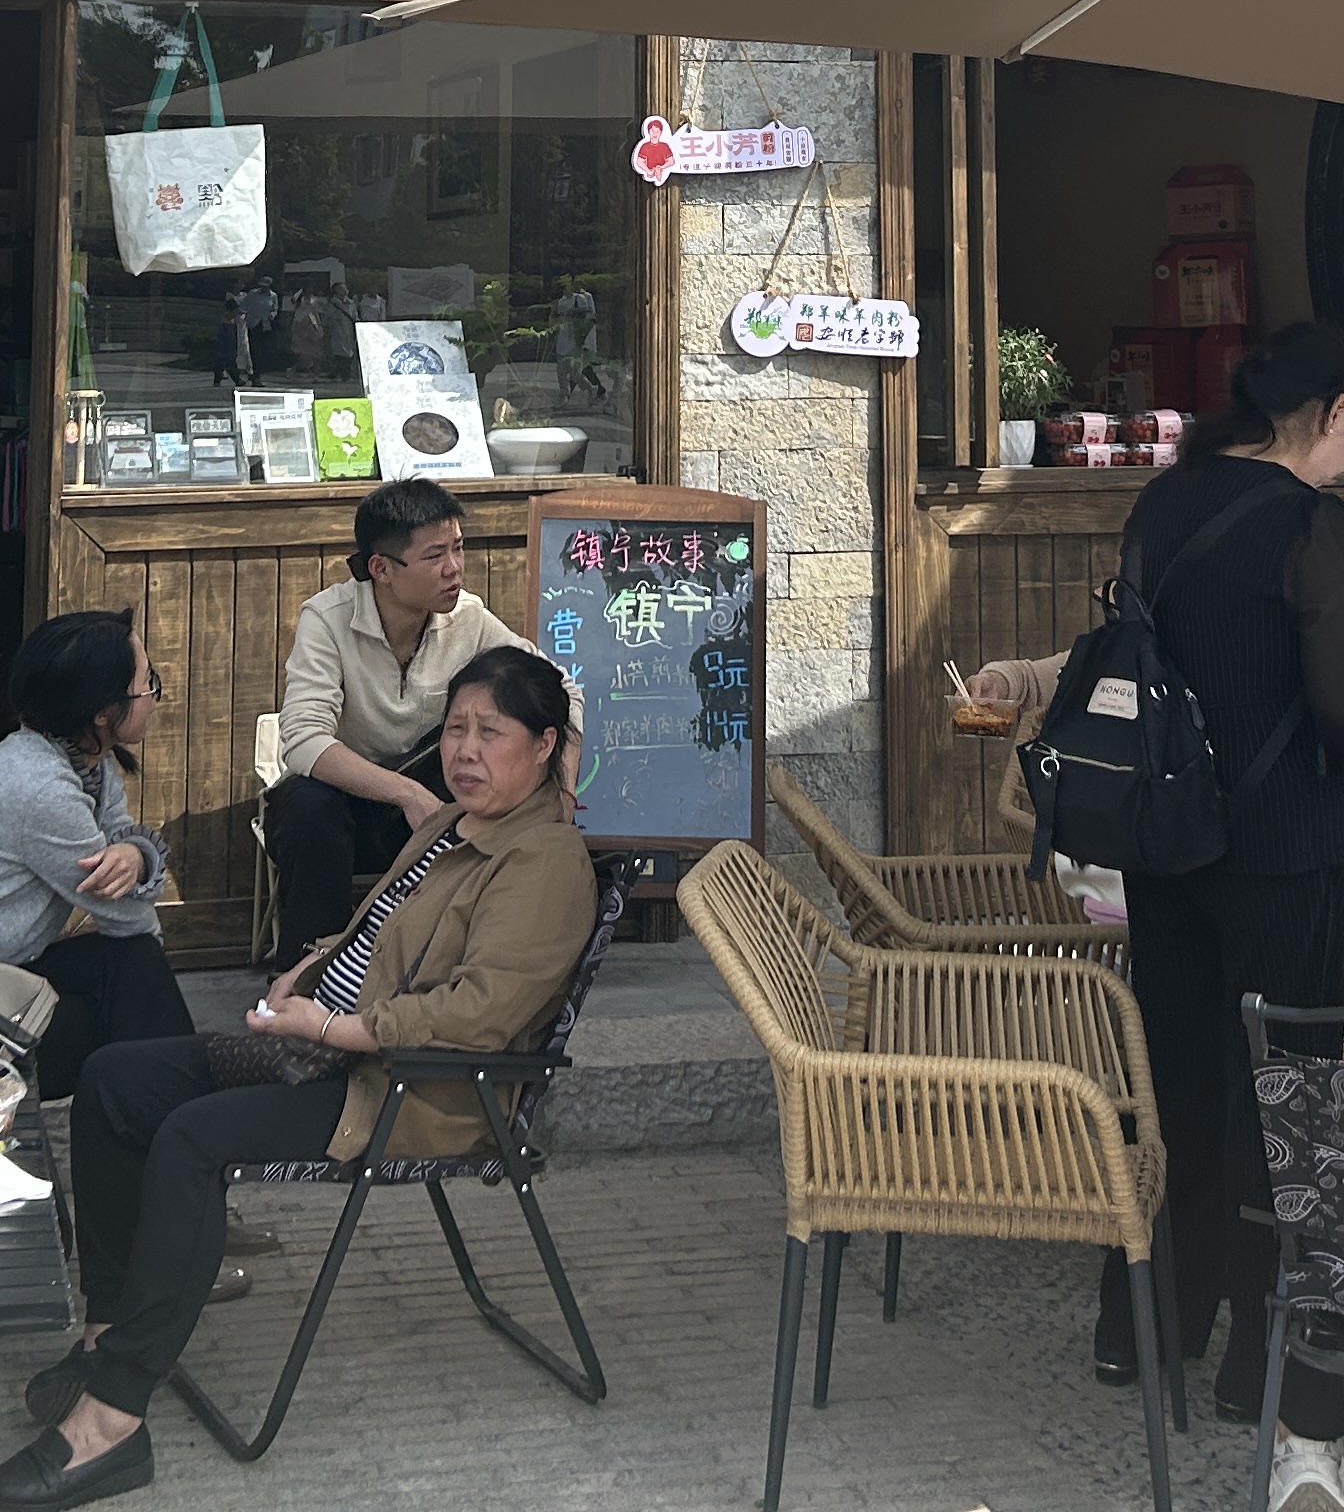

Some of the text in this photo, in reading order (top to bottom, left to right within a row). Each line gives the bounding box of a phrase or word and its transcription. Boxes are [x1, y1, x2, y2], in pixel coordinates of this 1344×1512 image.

[679, 132, 759, 158] 王小芳
[570, 527, 707, 574] 镇宁故事
[607, 584, 712, 646] 镇宁
